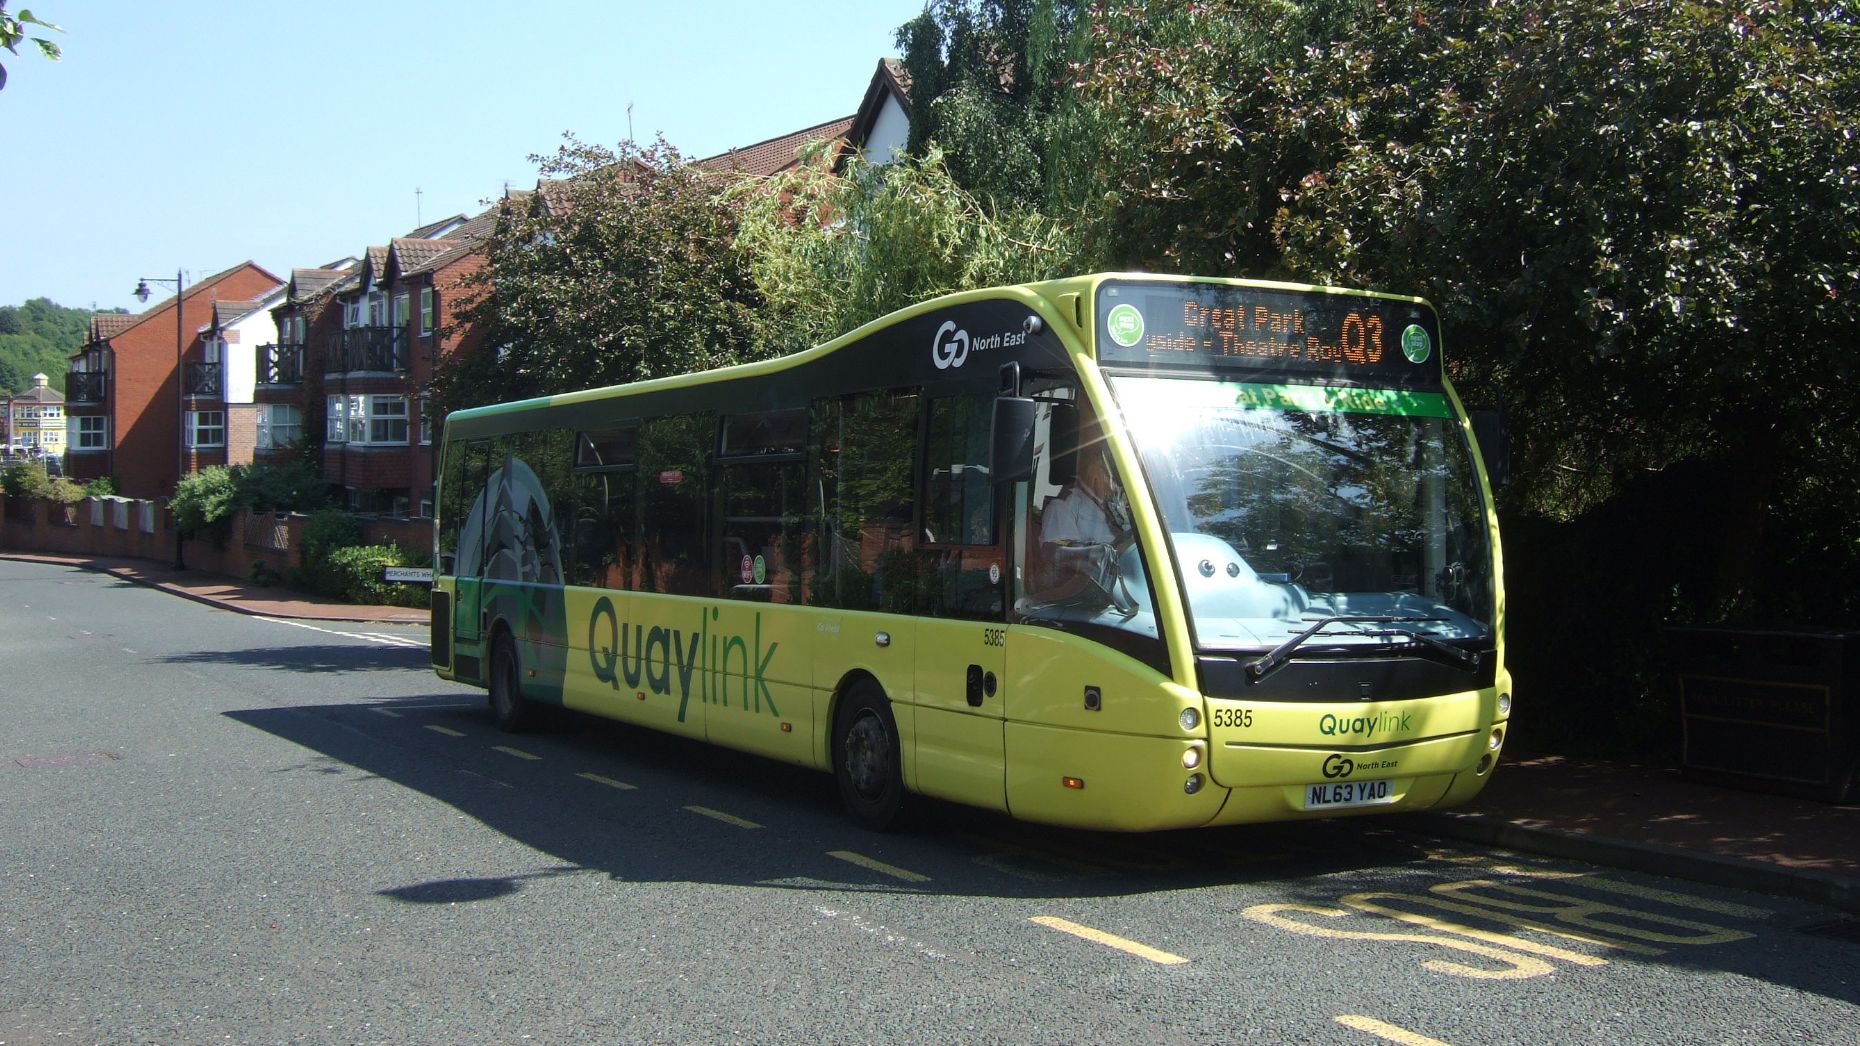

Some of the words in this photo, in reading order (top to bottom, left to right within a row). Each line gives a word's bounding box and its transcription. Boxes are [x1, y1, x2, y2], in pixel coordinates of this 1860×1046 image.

[1184, 300, 1246, 331] Great
[1254, 305, 1305, 335] Park
[972, 334, 1001, 352] North
[1003, 330, 1026, 347] East
[1219, 331, 1300, 359] Theatre
[1341, 312, 1383, 365] Q3
[984, 628, 1006, 647] 5385
[588, 595, 780, 723] Quaylink
[1213, 708, 1253, 728] 5385
[1319, 711, 1412, 738] Quaylink
[1356, 762, 1379, 770] North
[1381, 760, 1399, 769] East
[1311, 784, 1354, 804] NL63
